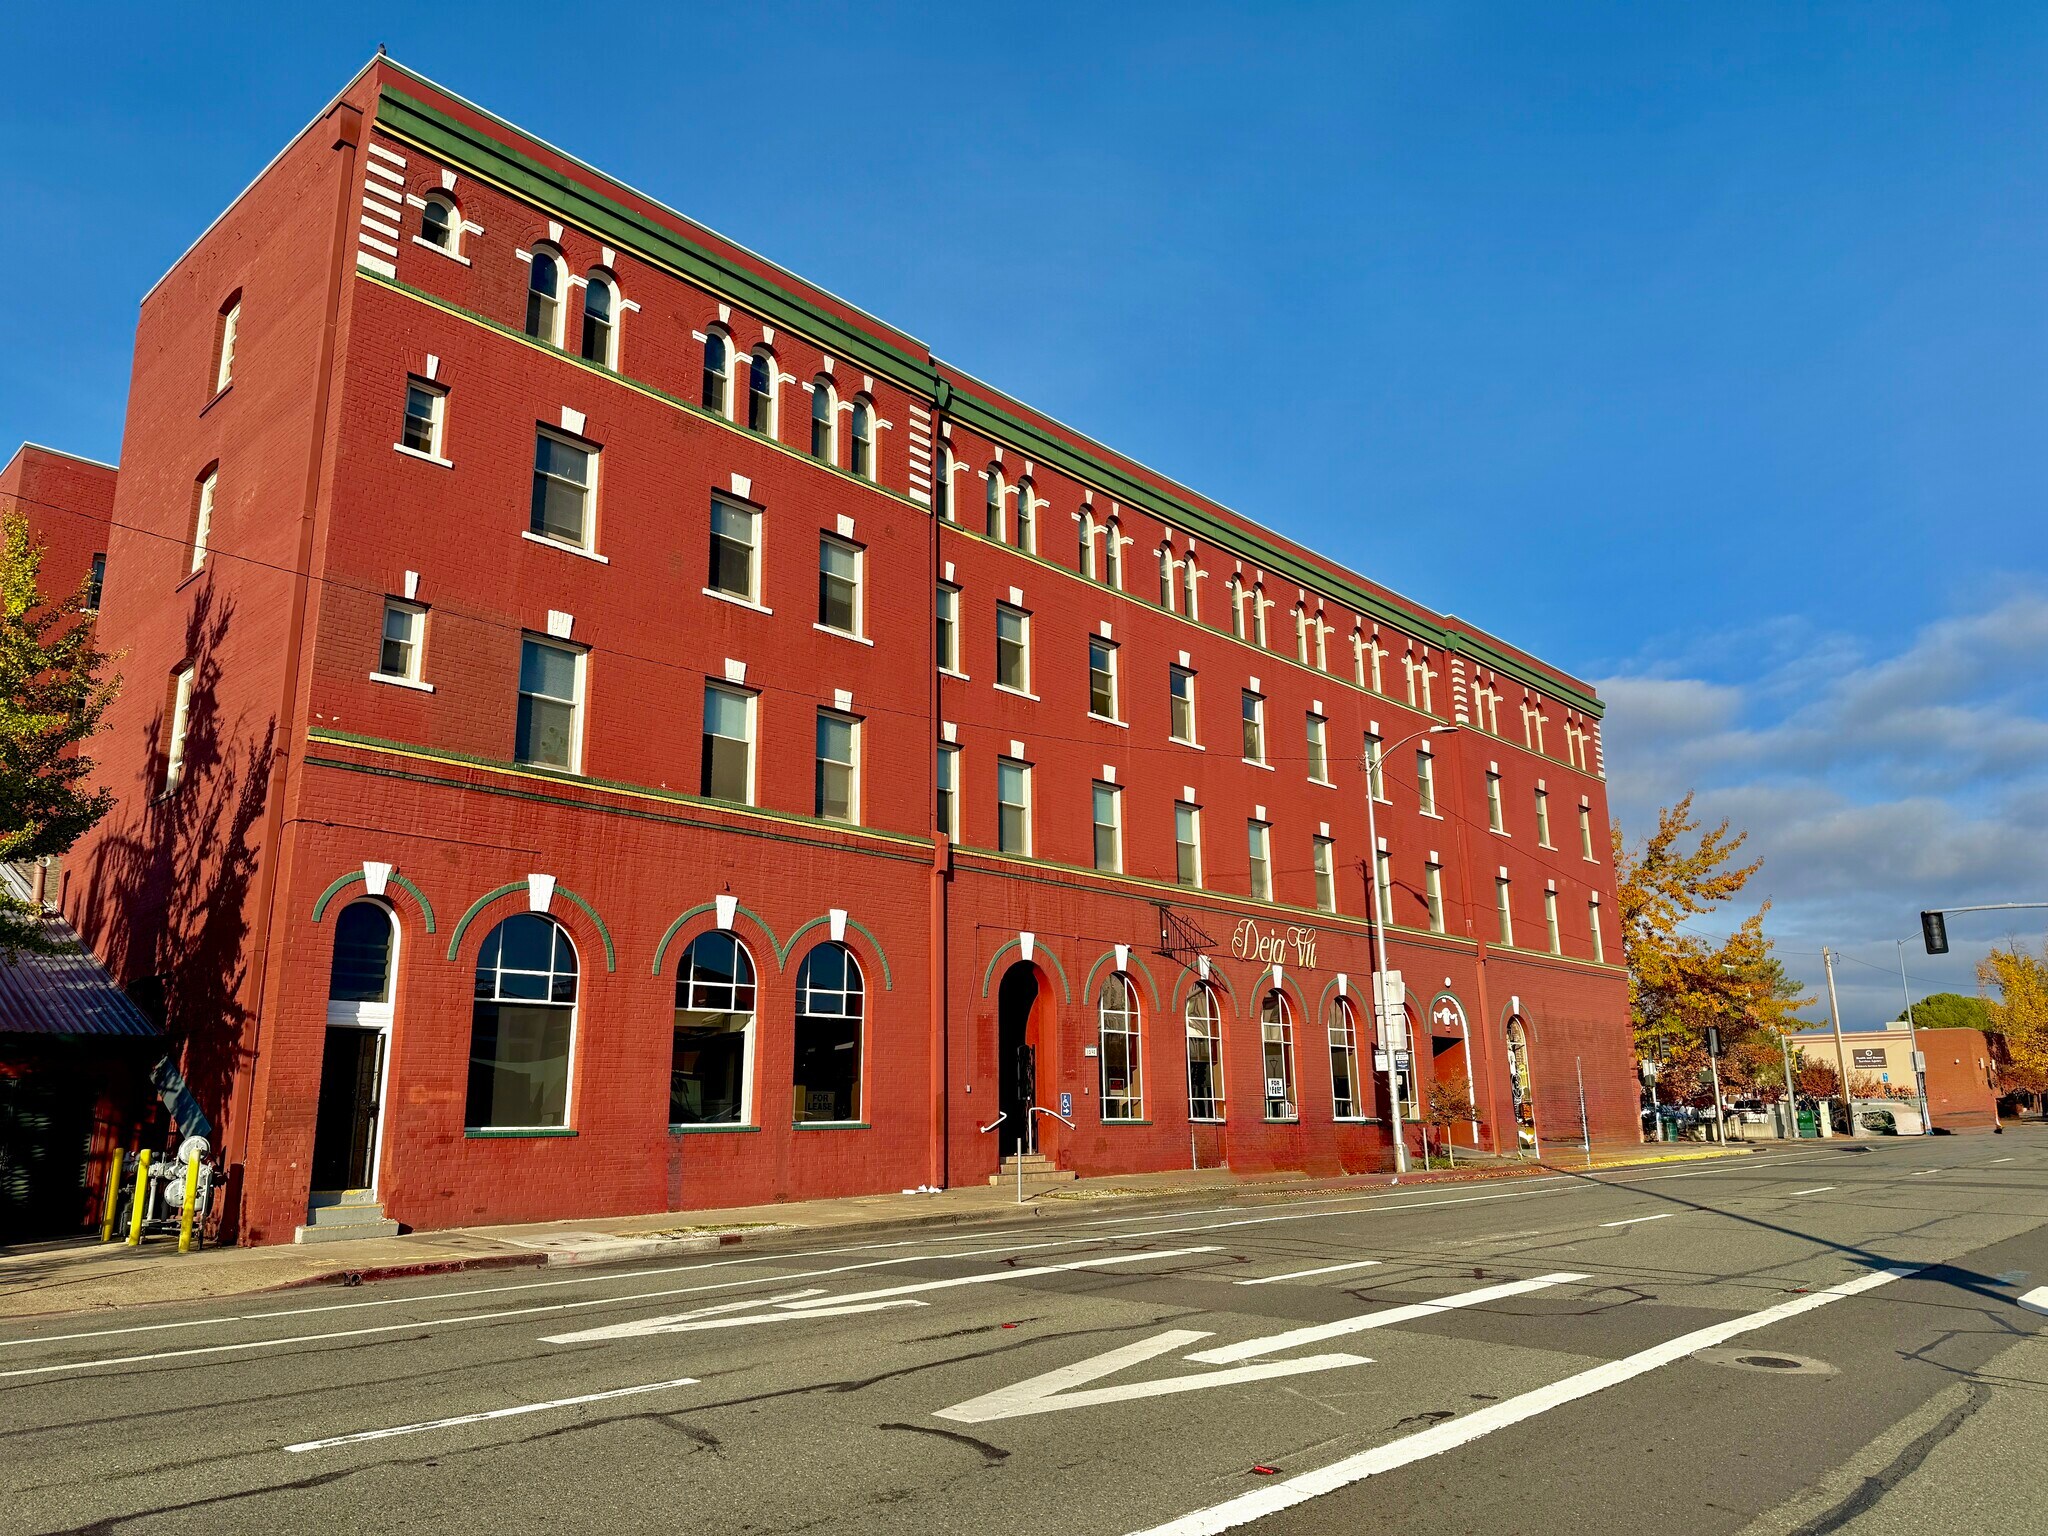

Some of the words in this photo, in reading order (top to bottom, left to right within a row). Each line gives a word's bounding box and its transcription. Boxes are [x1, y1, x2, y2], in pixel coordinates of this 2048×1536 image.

[1231, 918, 1286, 974] Deja
[1287, 926, 1317, 969] Vu
[812, 1094, 829, 1102] FOR
[807, 1102, 833, 1111] LEASE
